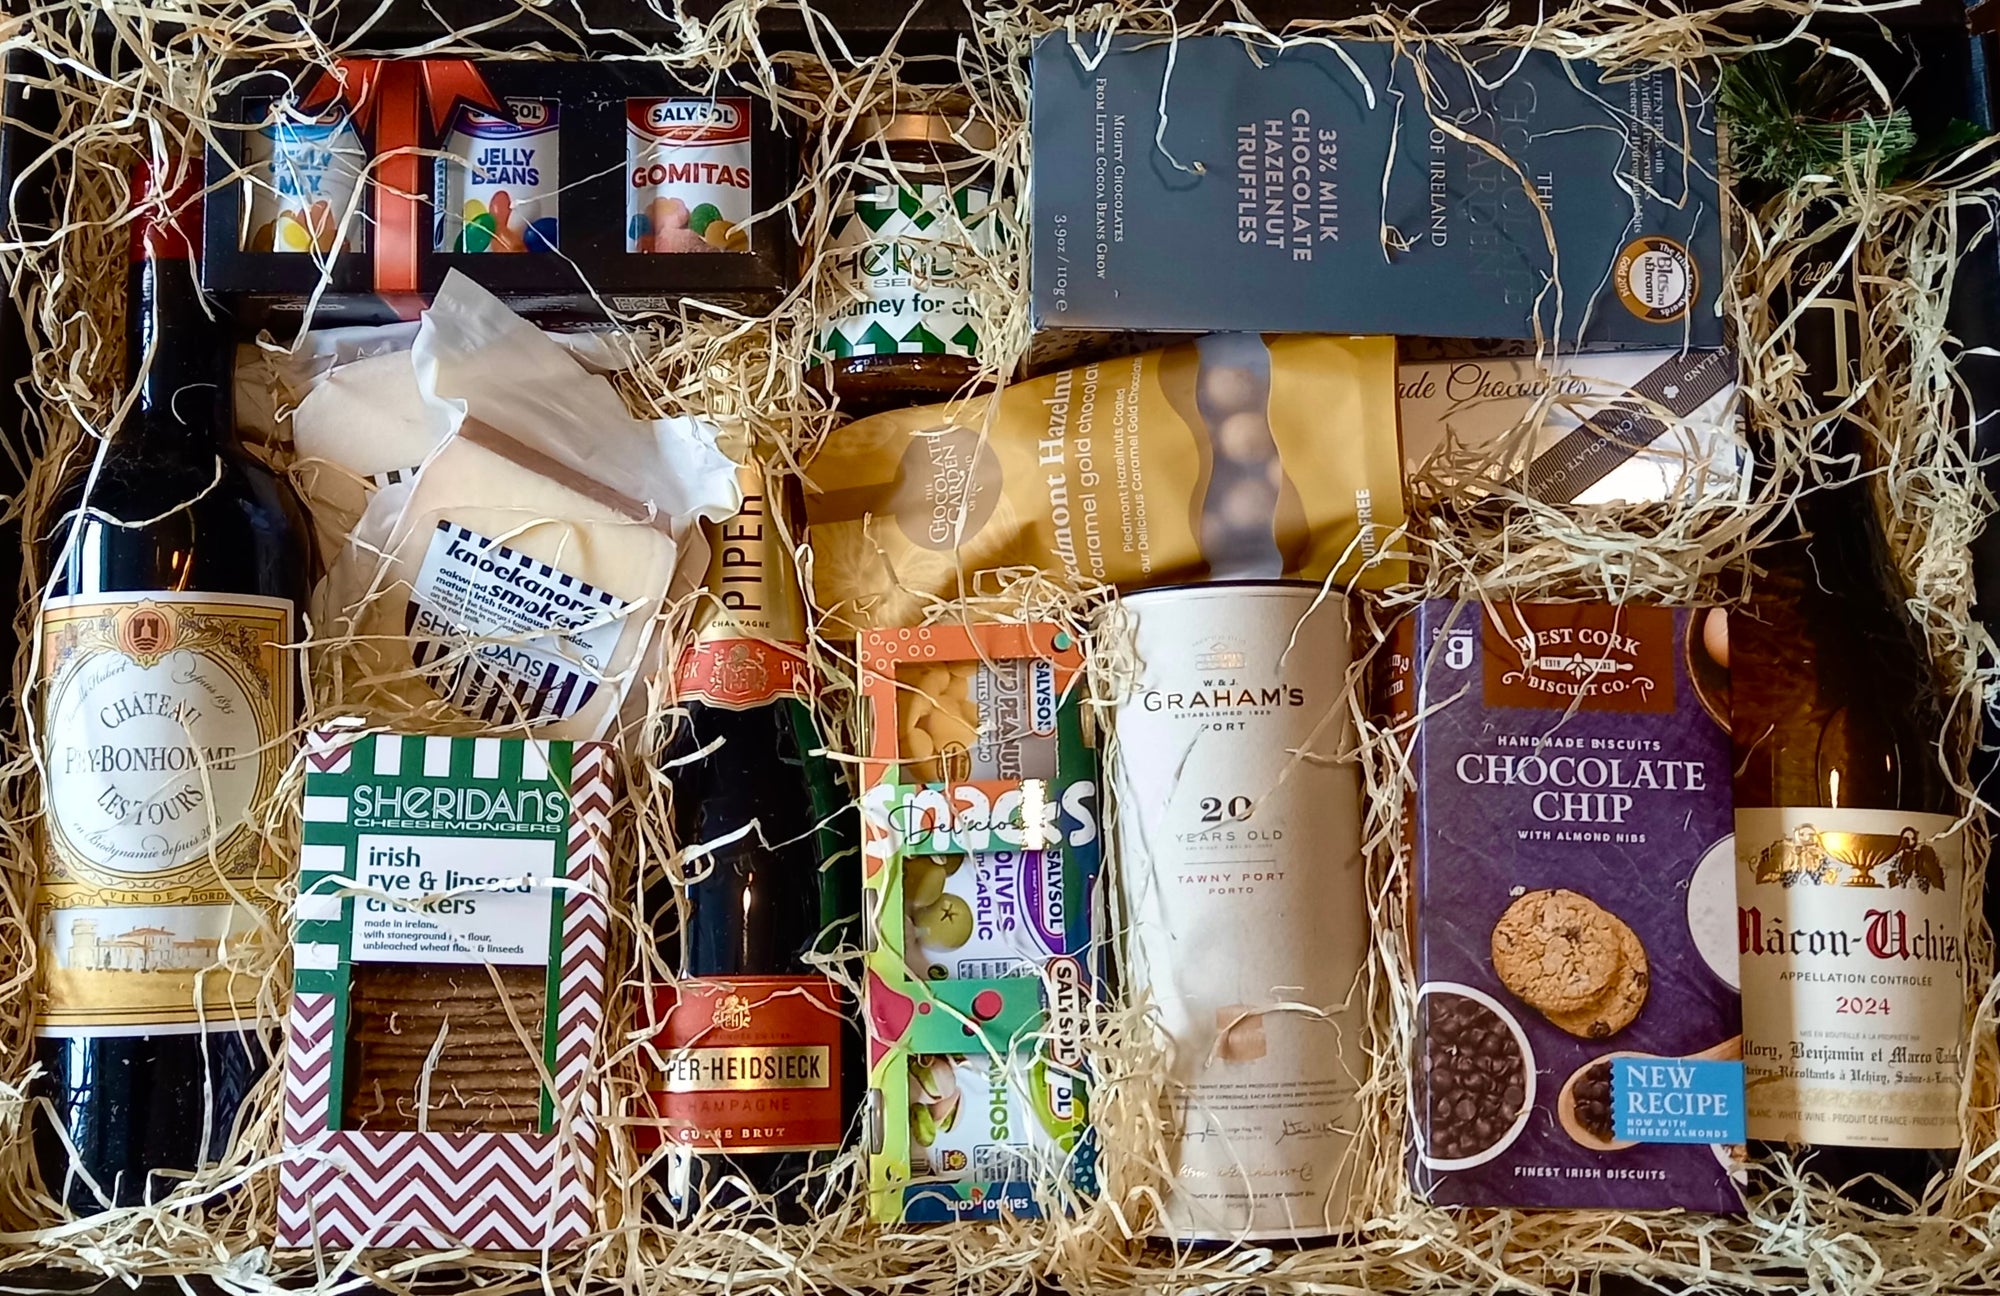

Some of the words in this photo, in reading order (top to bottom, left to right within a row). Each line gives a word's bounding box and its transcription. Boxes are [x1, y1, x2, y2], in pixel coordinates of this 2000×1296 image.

[652, 101, 734, 124] SALYSOL
[1318, 129, 1337, 173] 33%
[1430, 128, 1446, 156] OF
[477, 148, 535, 166] JELLY
[471, 167, 540, 187] BEANS
[631, 163, 751, 189] GOMITAS
[1237, 123, 1258, 244] TRUFFLES
[1264, 119, 1285, 249] HAZELNUT
[1290, 108, 1312, 262] CHOCOLATE
[1536, 170, 1554, 211] THE
[1319, 180, 1339, 242] MILK
[1430, 160, 1448, 248] IRELAND
[1657, 256, 1675, 293] Blas
[912, 293, 945, 313] for
[1126, 399, 1139, 434] Gold
[1565, 418, 1633, 470] CHCOLATE
[1074, 437, 1099, 488] gold
[1112, 426, 1128, 490] Hazelnuts
[1128, 435, 1143, 492] Caramel
[926, 435, 950, 543] CHOCOLATE
[1355, 488, 1373, 526] FREE
[1116, 490, 1134, 553] Piedmont
[1136, 493, 1149, 551] Delicious
[1078, 492, 1106, 579] caramel
[446, 540, 600, 620] knockanore
[712, 620, 771, 629] CHAAGNE
[1513, 628, 1574, 651] WEST
[1578, 628, 1642, 656] CORK
[1218, 679, 1226, 687] &
[1143, 684, 1305, 712] GRAHAM'S
[1174, 710, 1243, 719] ESTABLISHED
[1200, 721, 1247, 732] PORT
[1497, 734, 1584, 748] HANDMADE
[1591, 738, 1663, 752] BISCUITS
[1455, 752, 1708, 791] CHOCOLATE
[1200, 795, 1253, 823] 20
[1532, 790, 1634, 824] CHIP
[353, 818, 562, 833] CHEESEMONGERS
[1175, 830, 1236, 843] YEARS
[1247, 830, 1283, 841] OLD
[1517, 829, 1552, 840] WITH
[1555, 830, 1611, 842] ALMOND
[1615, 832, 1647, 843] NIBS
[369, 846, 421, 867] irish
[418, 870, 438, 891] &
[1046, 850, 1063, 929] SALYSOL
[1177, 872, 1233, 884] TAWNY
[1242, 872, 1286, 882] PORT
[1208, 886, 1255, 895] PORTO
[110, 891, 140, 902] VIN
[152, 891, 174, 902] DE
[994, 850, 1015, 932] OLIVES
[363, 930, 385, 940] with
[387, 930, 447, 941] stoneground
[364, 919, 391, 928] made
[393, 919, 403, 928] in
[363, 942, 418, 951] unbleached
[1779, 971, 1866, 985] APPELLATION
[1835, 996, 1891, 1015] 2024
[1789, 1041, 1864, 1063] Benjamin
[1870, 1050, 1883, 1062] et
[1888, 1047, 1932, 1068] Marco
[1626, 1065, 1697, 1089] NEW
[676, 1098, 791, 1115] HAMPAGNE
[1627, 1091, 1729, 1116] RECIPE
[1627, 1118, 1653, 1128] NOW
[1658, 1119, 1687, 1128] WITH
[1777, 1110, 1803, 1121] WHITE
[1804, 1111, 1826, 1122] WINE
[1832, 1112, 1867, 1125] PRODUIT
[1868, 1114, 1878, 1125] DE
[1880, 1114, 1908, 1126] FRANCE
[741, 1128, 786, 1140] BRUT
[1627, 1127, 1670, 1138] NIBBED
[1674, 1128, 1729, 1139] ALMONDS
[1514, 1166, 1560, 1178] FINEST
[1565, 1167, 1601, 1179] IRISH
[1606, 1169, 1667, 1181] BISCUITS
